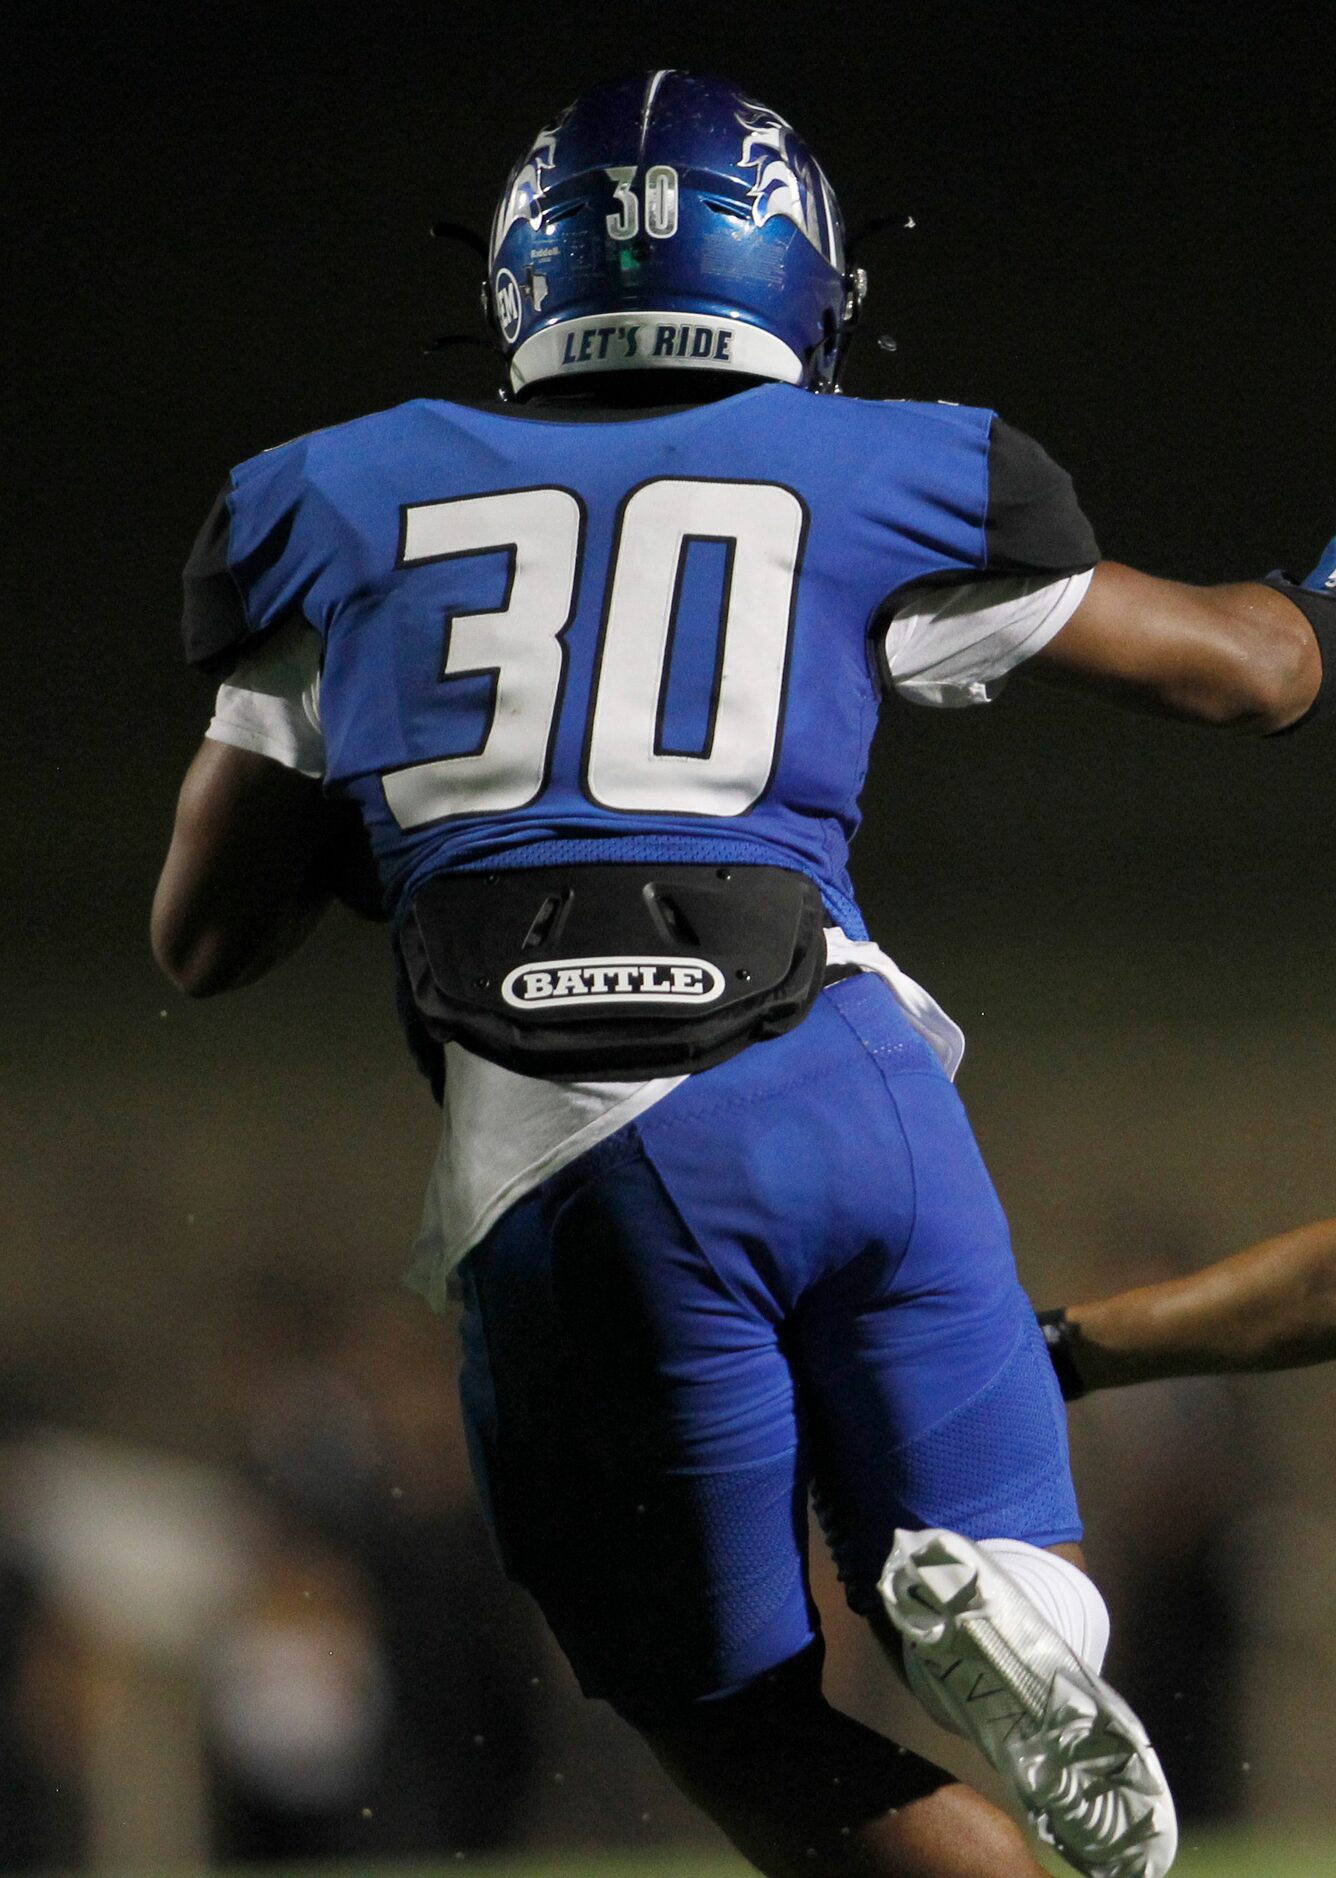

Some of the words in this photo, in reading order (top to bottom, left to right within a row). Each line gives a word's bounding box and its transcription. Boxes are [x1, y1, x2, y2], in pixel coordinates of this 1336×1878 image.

[604, 165, 679, 240] 30
[561, 325, 642, 365] LET'S
[652, 324, 733, 362] RIDE
[379, 474, 811, 832] 30
[522, 966, 704, 1000] BATTLE
